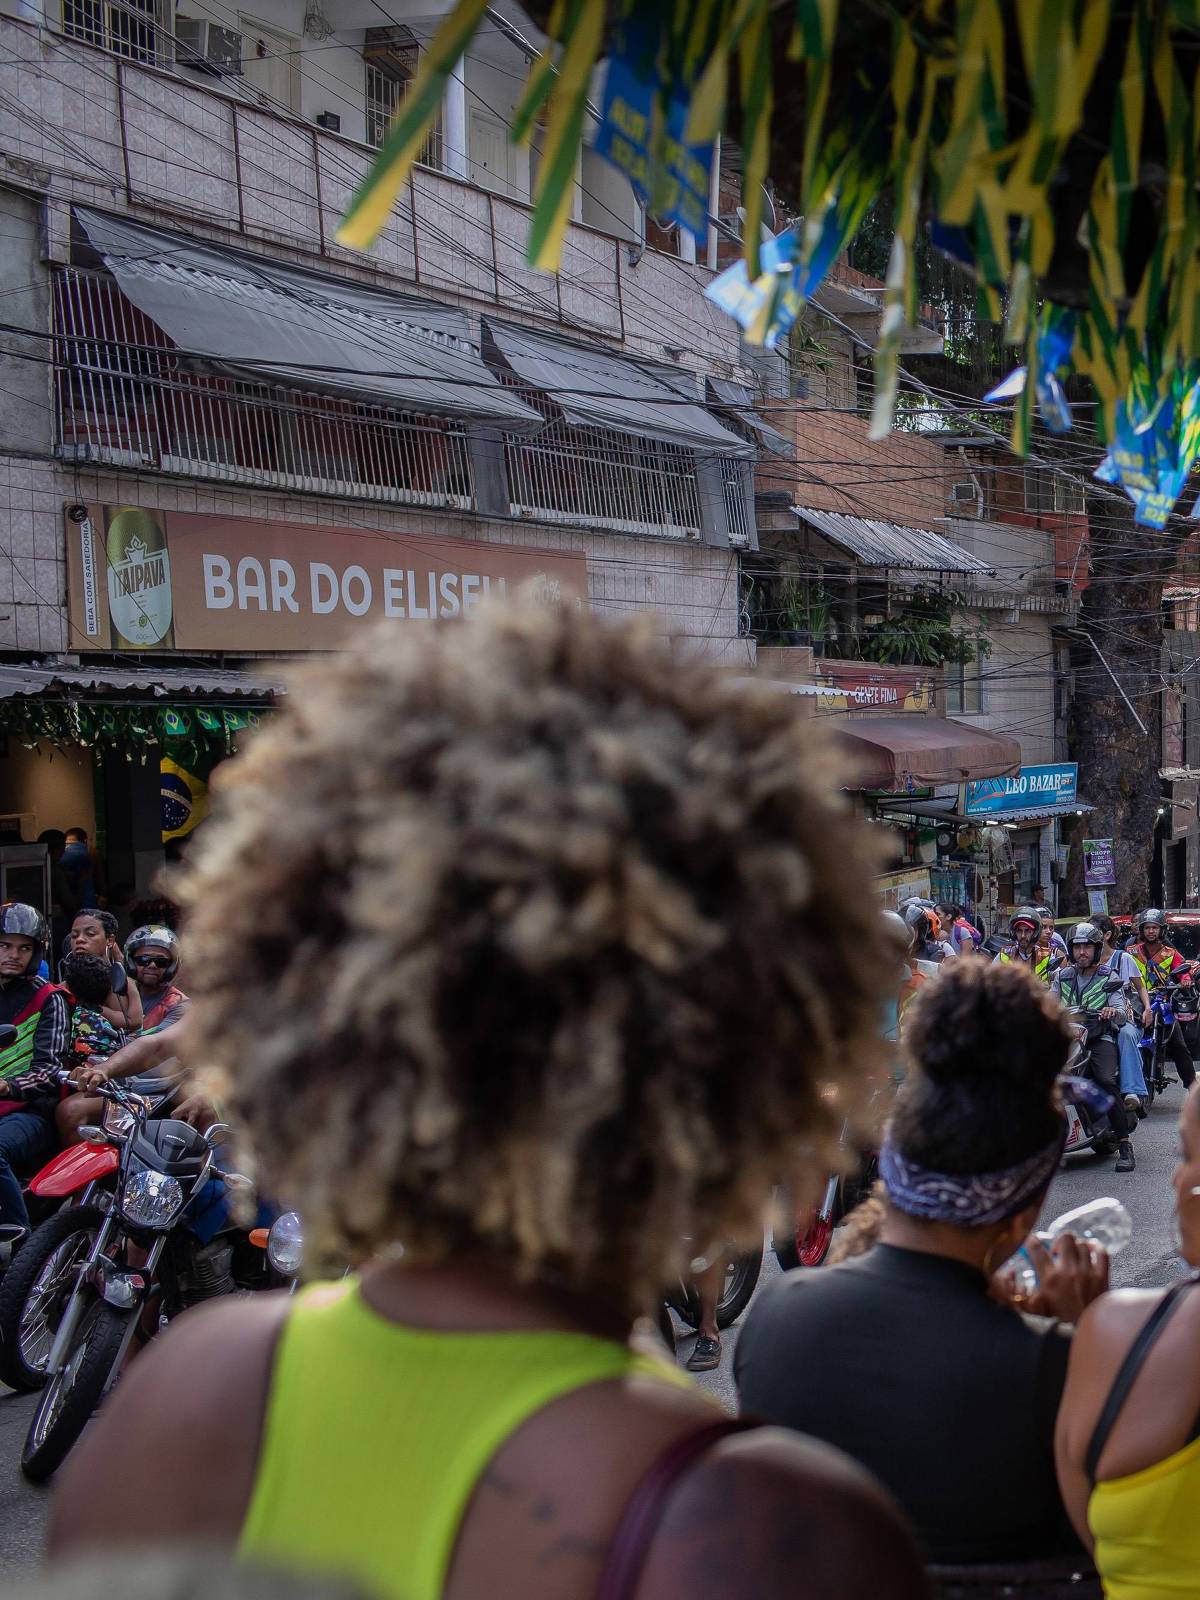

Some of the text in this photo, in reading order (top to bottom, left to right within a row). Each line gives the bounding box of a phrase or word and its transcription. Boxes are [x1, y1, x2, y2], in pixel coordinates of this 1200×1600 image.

[82, 522, 92, 578] SABEDORIA
[114, 558, 165, 599] ITAIPAVA
[202, 553, 299, 613] BAR
[309, 562, 372, 617] DO
[854, 686, 898, 704] GENTE FINA
[1005, 776, 1027, 794] LEO
[1029, 773, 1061, 792] BAZAR
